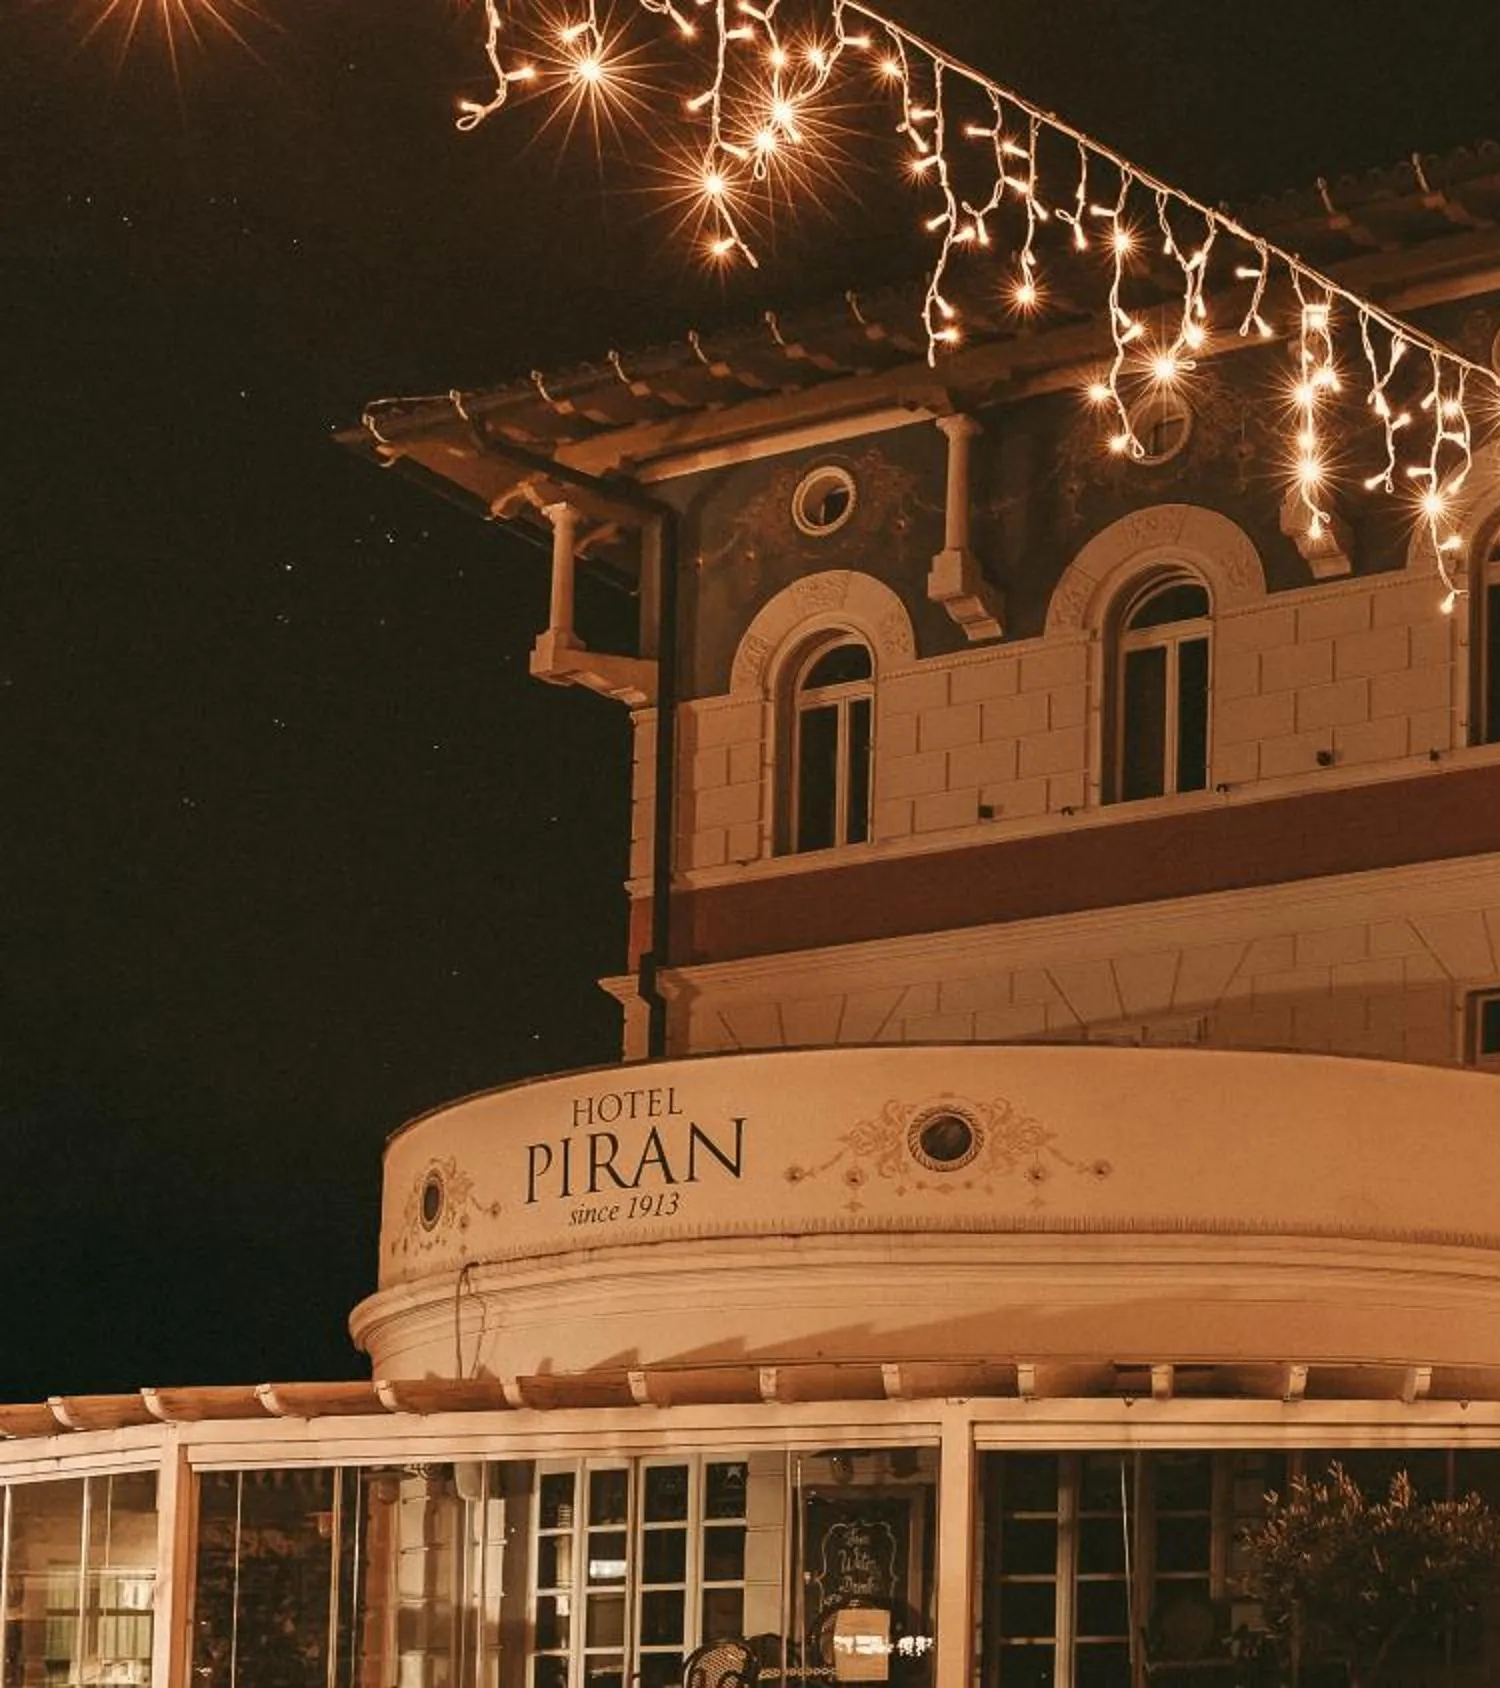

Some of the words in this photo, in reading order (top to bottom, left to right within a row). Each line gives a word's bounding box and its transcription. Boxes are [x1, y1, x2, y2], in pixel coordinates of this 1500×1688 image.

[572, 1087, 683, 1127] HOTEL
[524, 1117, 748, 1204] PIRAN
[568, 1203, 620, 1226] since
[627, 1190, 680, 1219] 1913
